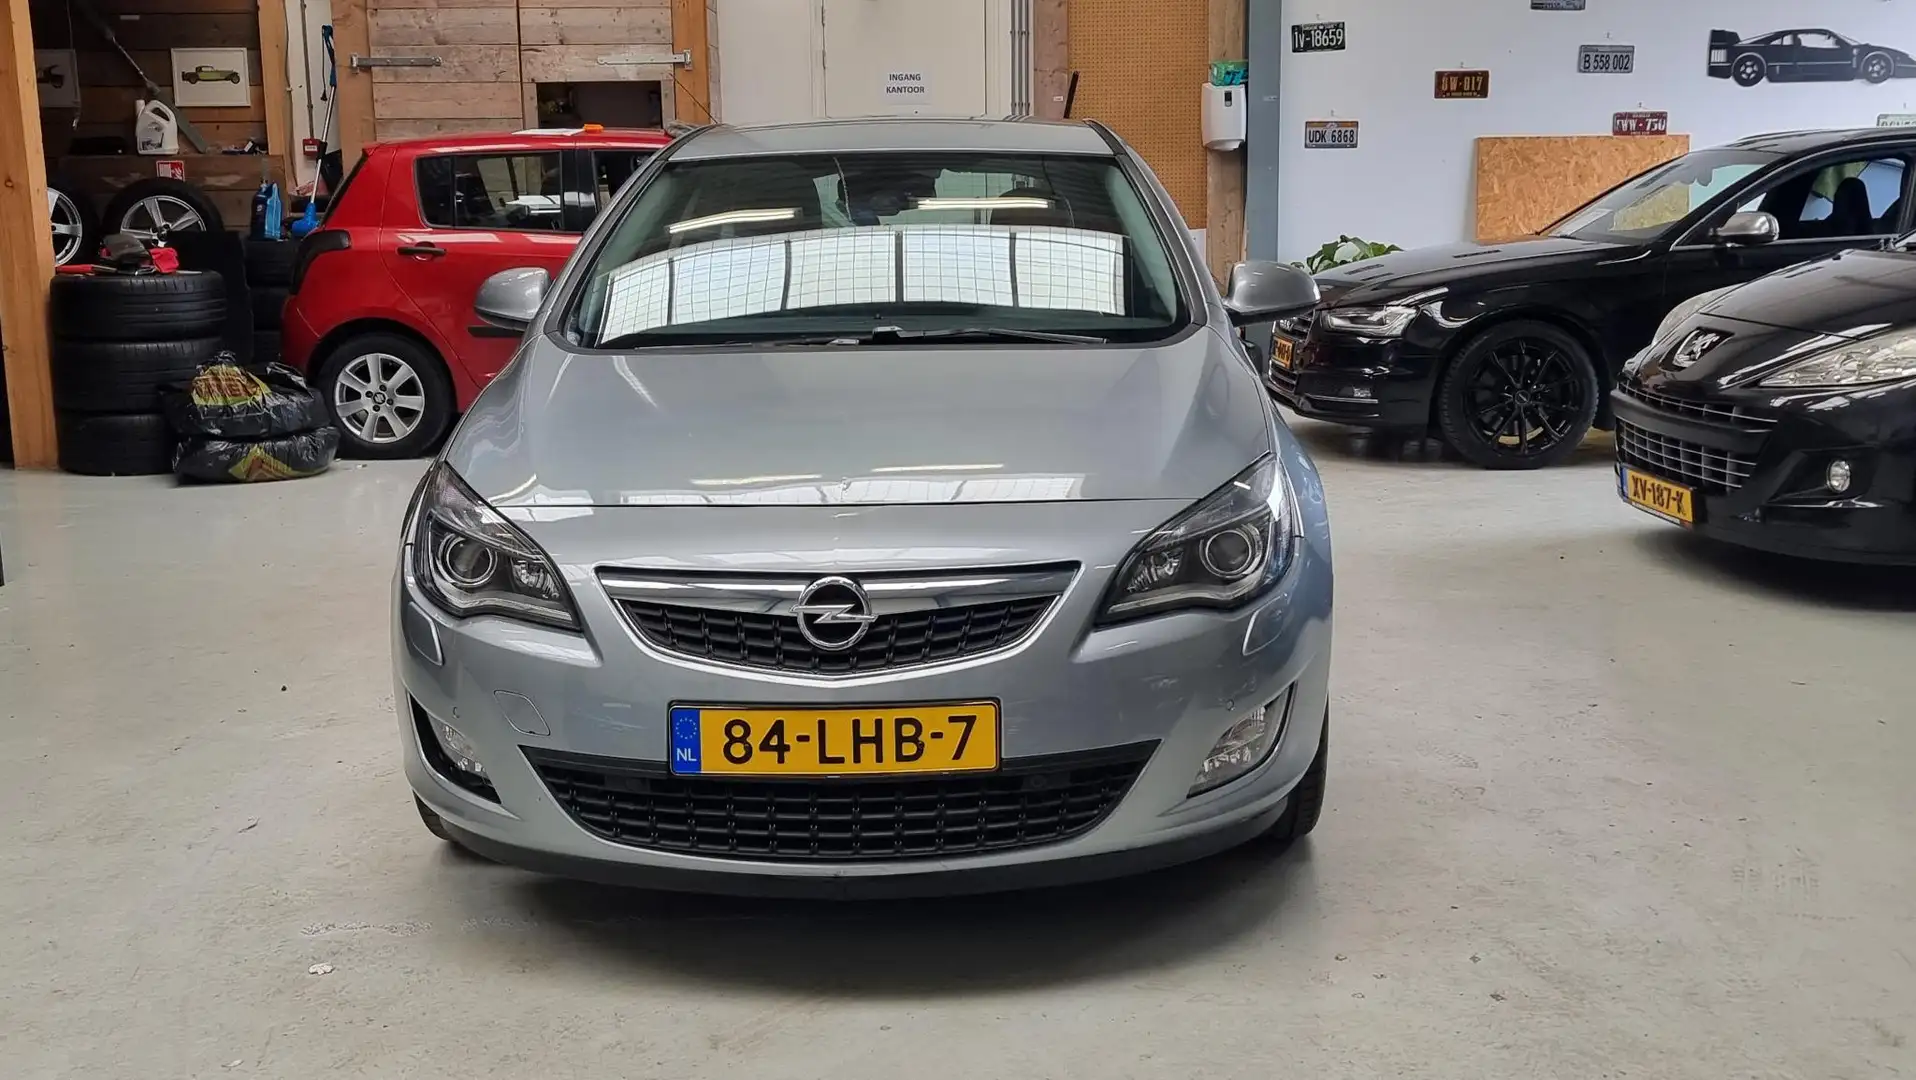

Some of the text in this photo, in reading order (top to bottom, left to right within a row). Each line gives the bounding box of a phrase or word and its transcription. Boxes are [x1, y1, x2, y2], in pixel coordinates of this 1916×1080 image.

[1583, 53, 1630, 70] B 558 002
[889, 73, 921, 81] INGANG
[886, 86, 925, 94] KANTOOR
[1308, 129, 1355, 143] UDK 6868
[1631, 474, 1687, 516] XV-187-K
[722, 714, 978, 765] 84-LHB-7
[676, 748, 697, 762] NL
